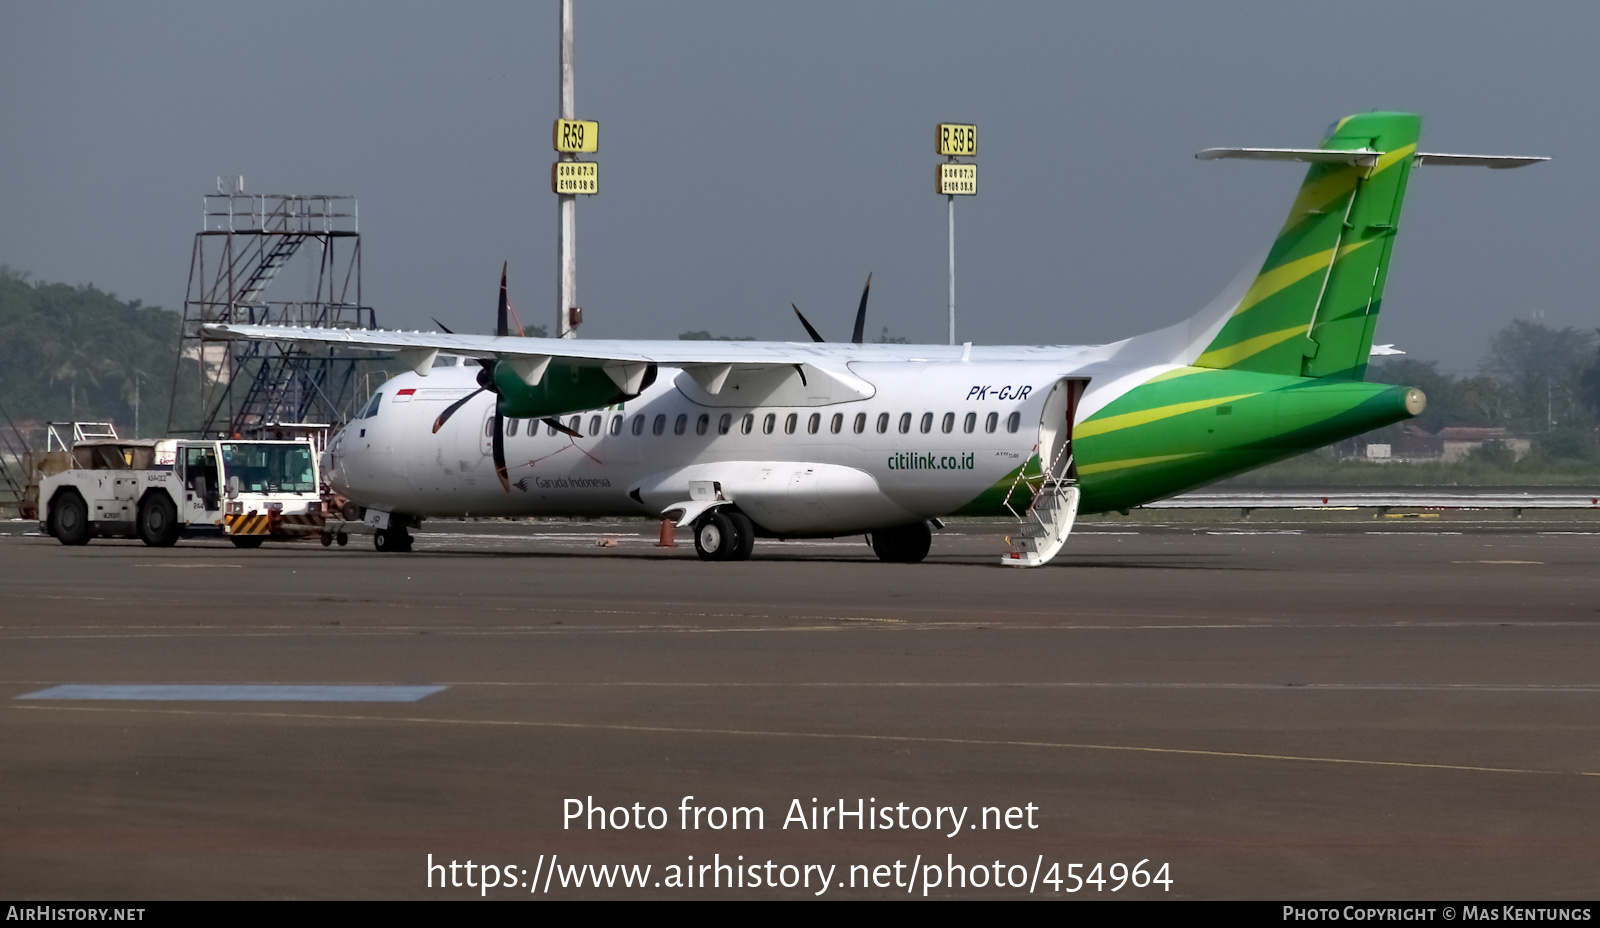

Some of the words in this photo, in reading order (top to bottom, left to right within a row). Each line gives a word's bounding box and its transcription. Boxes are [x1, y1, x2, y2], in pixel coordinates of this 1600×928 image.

[563, 123, 584, 149] R59
[943, 127, 950, 152] R
[953, 128, 965, 152] 59
[967, 128, 974, 152] B
[966, 385, 1033, 400] PK-GJR
[887, 452, 974, 470] citilink.co.id
[535, 477, 568, 489] Garuda
[568, 477, 611, 488] Indonesia
[370, 515, 381, 525] JR
